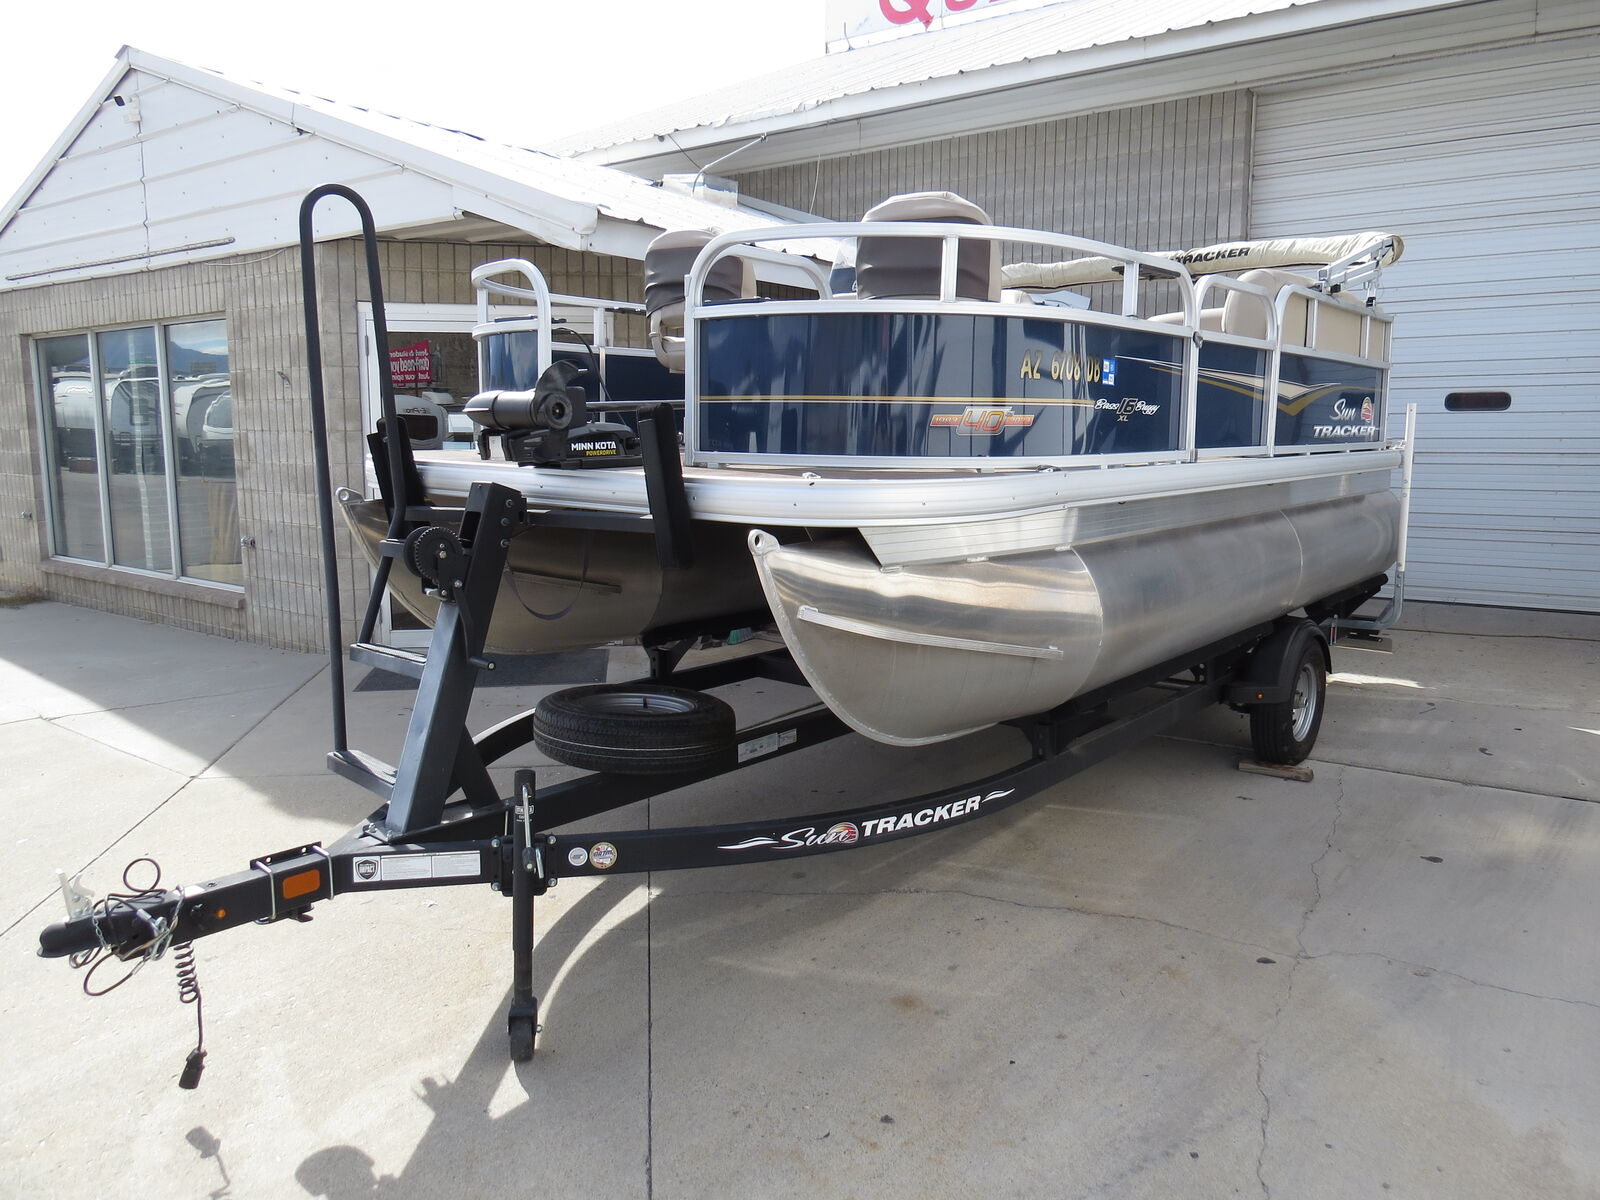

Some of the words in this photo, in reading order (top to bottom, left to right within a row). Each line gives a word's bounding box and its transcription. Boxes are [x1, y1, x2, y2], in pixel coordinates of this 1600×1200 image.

[1174, 247, 1251, 264] TRACKER
[1020, 349, 1043, 379] AZ
[1095, 399, 1120, 410] Bass
[1116, 398, 1138, 414] 16
[1135, 401, 1161, 415] Buggy
[1329, 398, 1357, 421] Sun
[964, 410, 1005, 431] 40
[1313, 424, 1376, 439] TRACKER
[571, 442, 594, 451] MINN
[595, 441, 617, 450] KOTA
[771, 827, 851, 849] Sun
[861, 795, 982, 838] TRACKER
